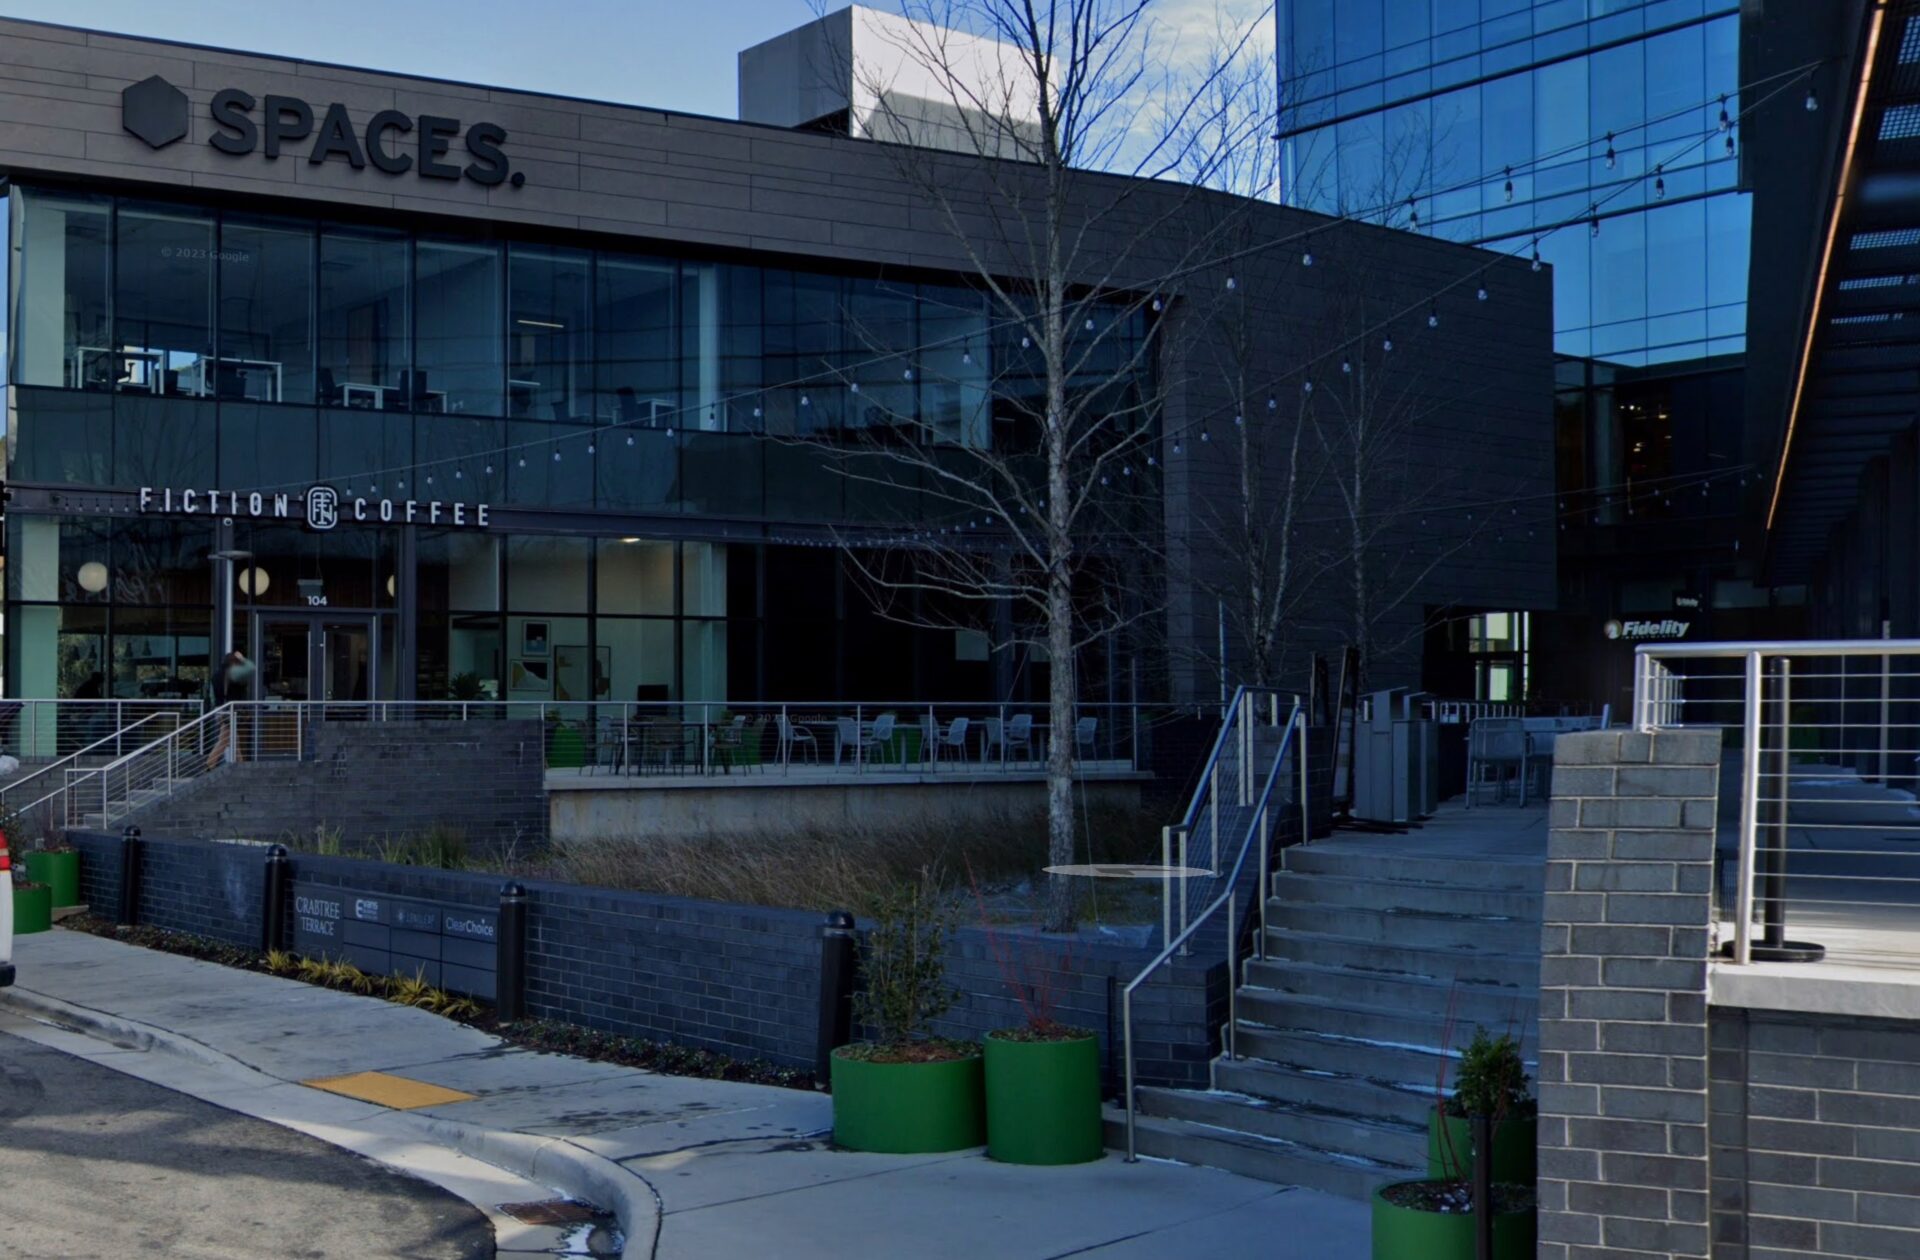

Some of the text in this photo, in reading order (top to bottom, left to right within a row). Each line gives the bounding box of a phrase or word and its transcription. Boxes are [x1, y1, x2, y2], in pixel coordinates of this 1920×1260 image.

[210, 87, 526, 188] SPACES.
[140, 486, 288, 517] FICTION
[354, 497, 489, 526] COFFEE
[307, 595, 328, 606] 104
[1622, 620, 1690, 637] Fidelity
[296, 896, 340, 920] CRABTREE
[301, 916, 335, 937] TERRACE
[445, 916, 494, 937] ClearChoice
